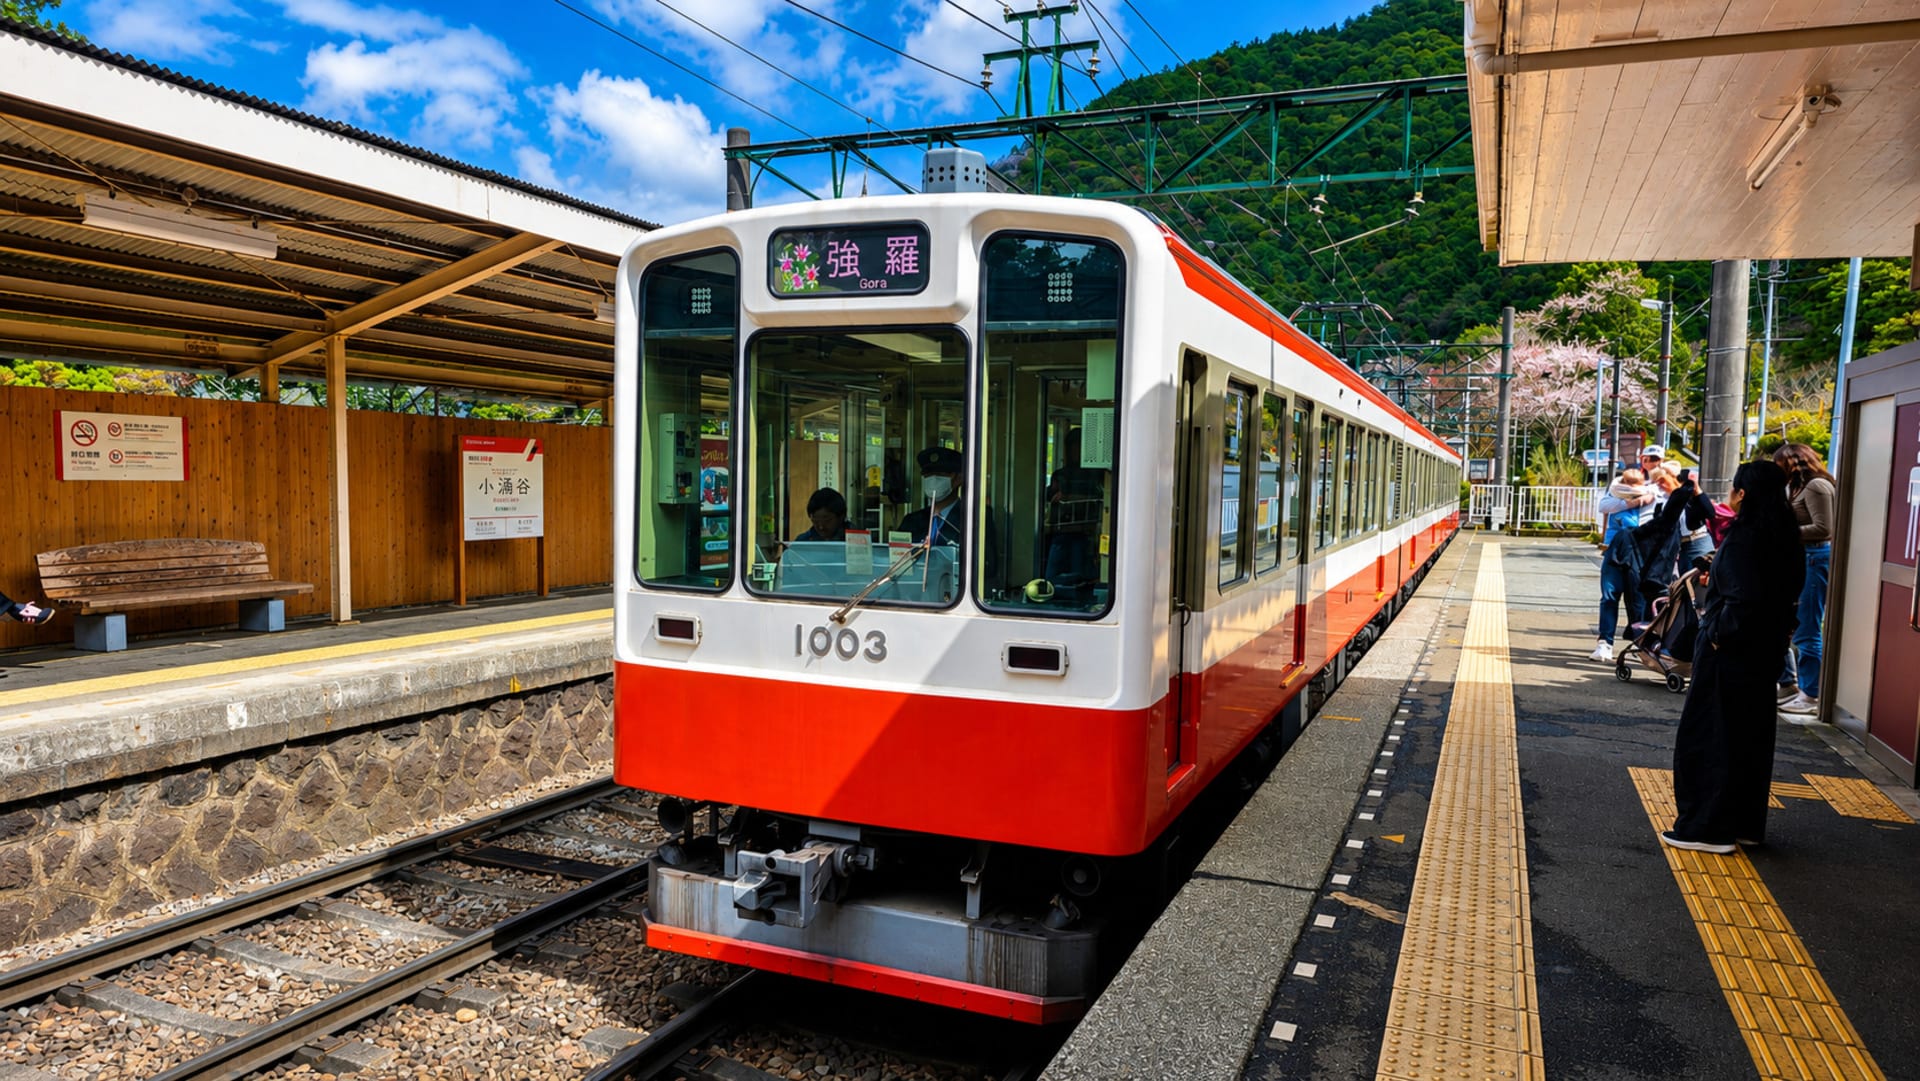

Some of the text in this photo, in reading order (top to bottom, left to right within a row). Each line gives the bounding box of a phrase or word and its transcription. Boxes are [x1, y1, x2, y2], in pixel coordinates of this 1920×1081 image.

[826, 235, 920, 278] 強羅
[859, 278, 887, 290] Gora
[478, 476, 531, 496] 小涌谷
[795, 624, 888, 663] 1003
